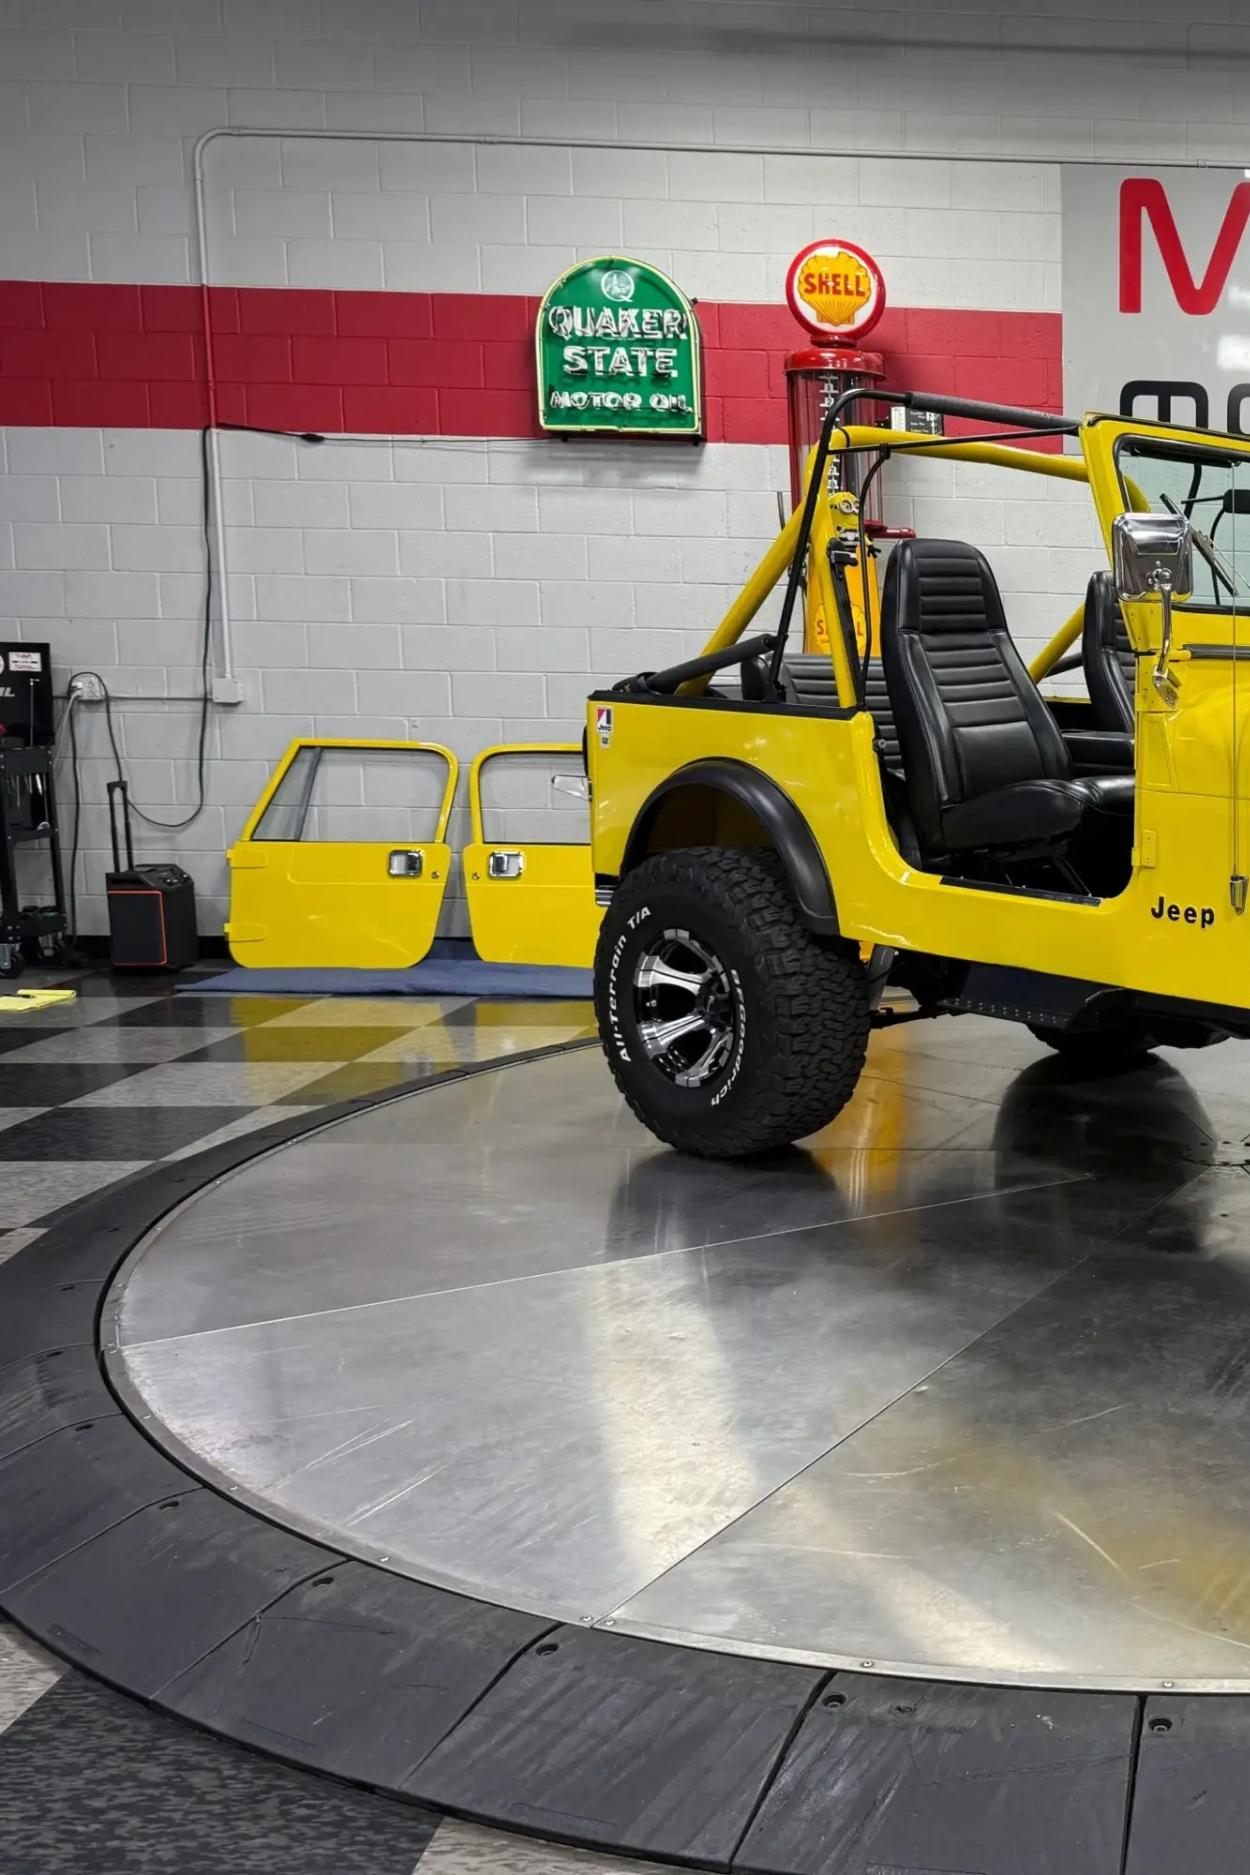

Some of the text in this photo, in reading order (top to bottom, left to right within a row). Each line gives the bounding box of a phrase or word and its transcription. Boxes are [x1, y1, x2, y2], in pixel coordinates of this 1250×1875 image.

[803, 272, 867, 298] SHELL
[548, 305, 688, 341] QUAKER
[563, 345, 679, 378] STATE
[550, 390, 693, 413] MOTOR OIL
[1151, 896, 1215, 929] Jeep
[609, 906, 651, 1062] All-Terrain T/A
